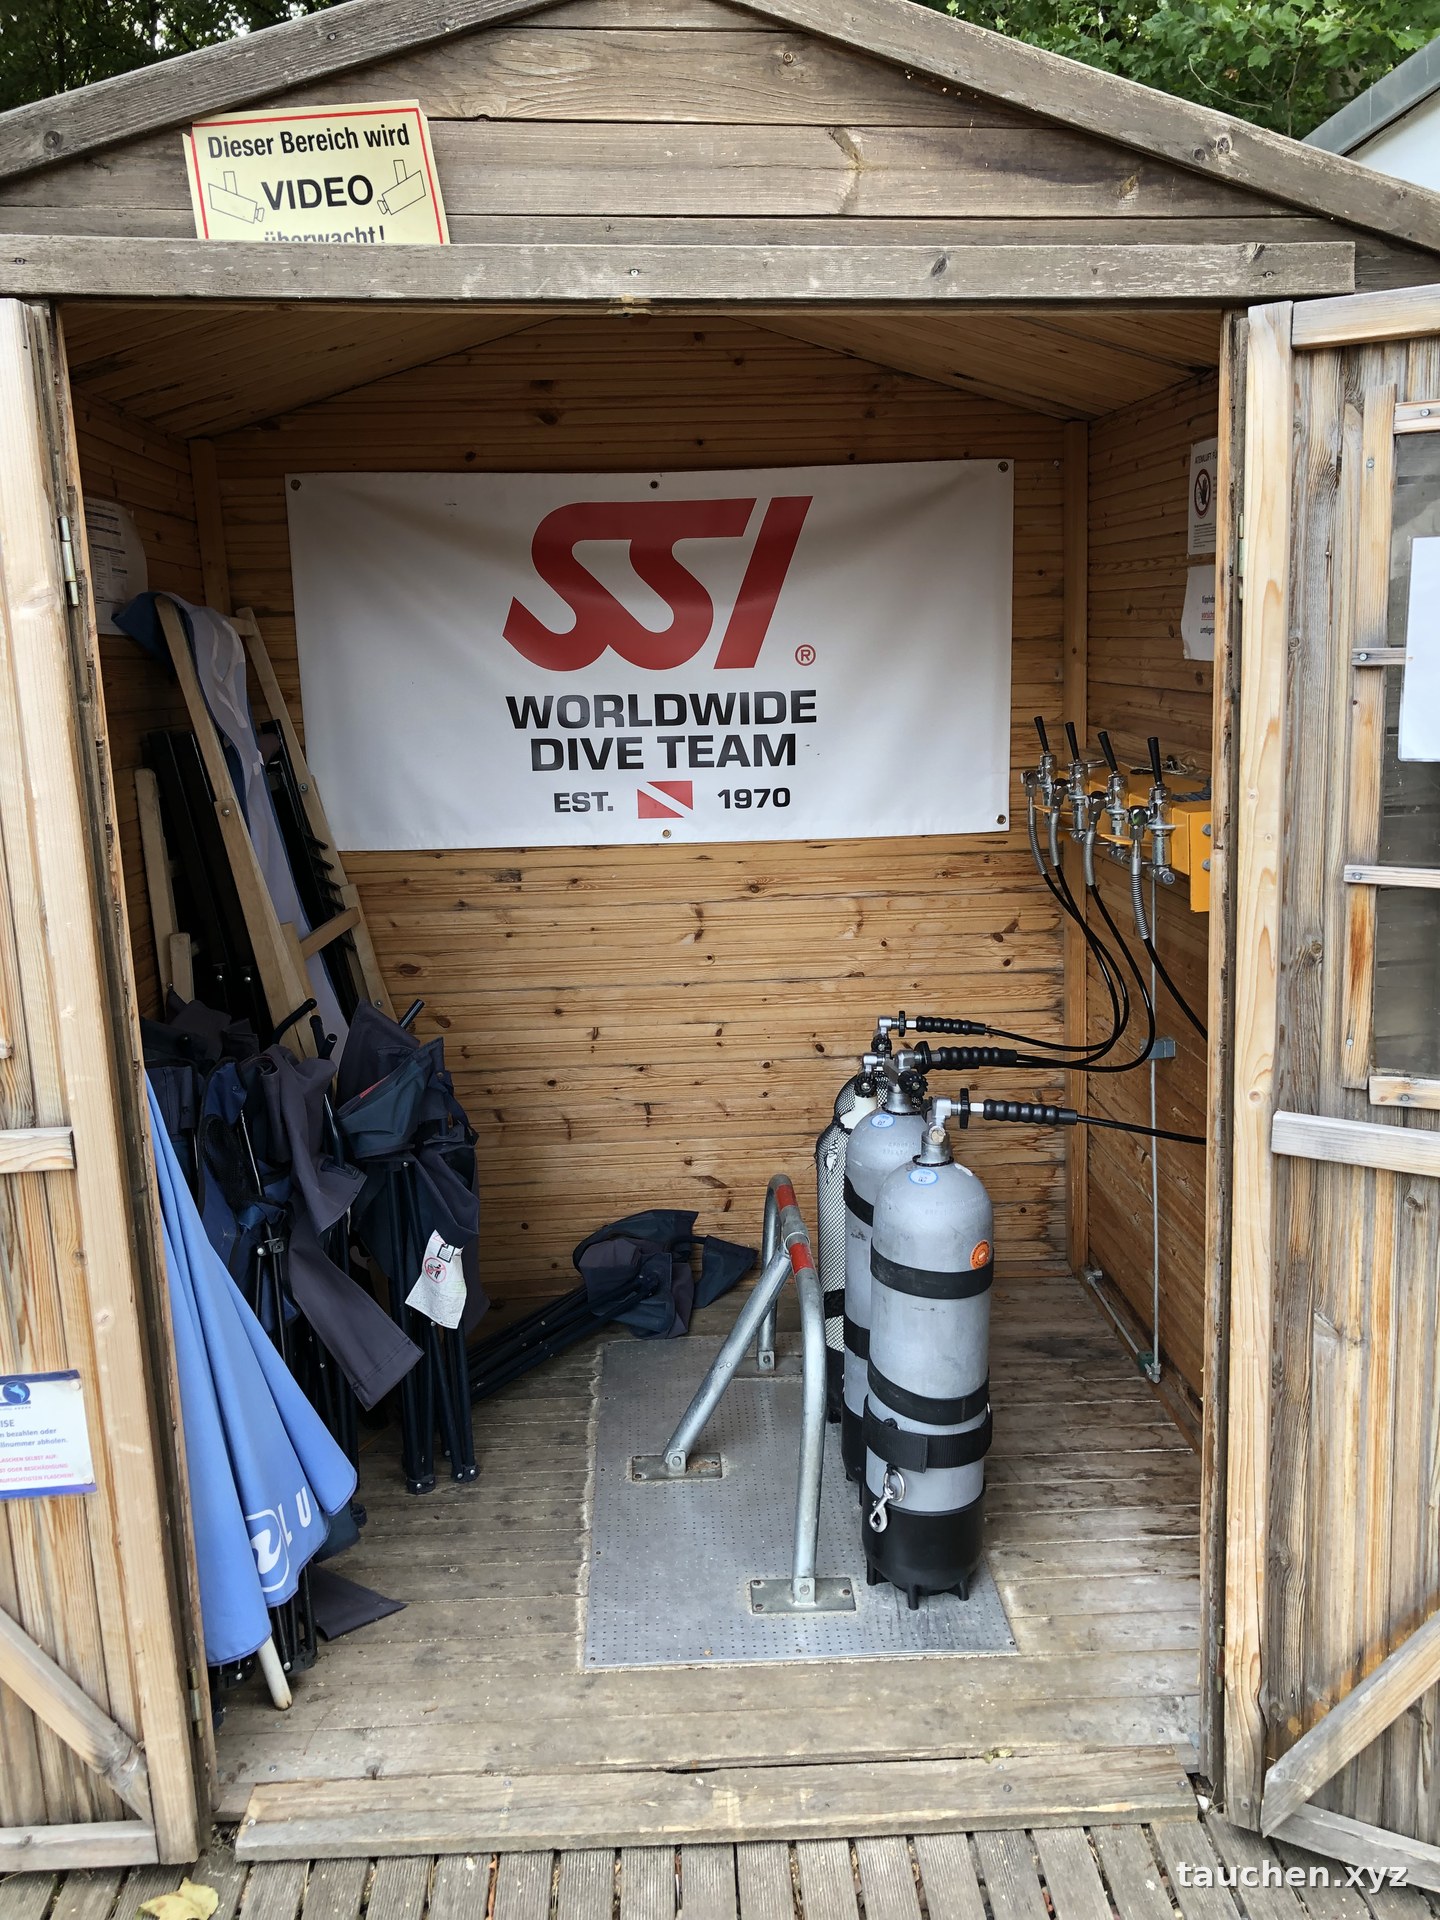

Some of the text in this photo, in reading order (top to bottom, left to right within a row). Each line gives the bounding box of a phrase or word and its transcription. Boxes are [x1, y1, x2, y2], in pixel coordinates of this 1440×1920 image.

[208, 123, 410, 159] Dieser Bereich wird
[261, 174, 373, 211] VIDEO
[502, 495, 814, 672] SSI
[505, 689, 817, 730] WORLDWIDE
[530, 733, 797, 772] DIVE TEAM
[553, 787, 791, 813] EST. 1970
[6, 1429, 39, 1438] bezahlen
